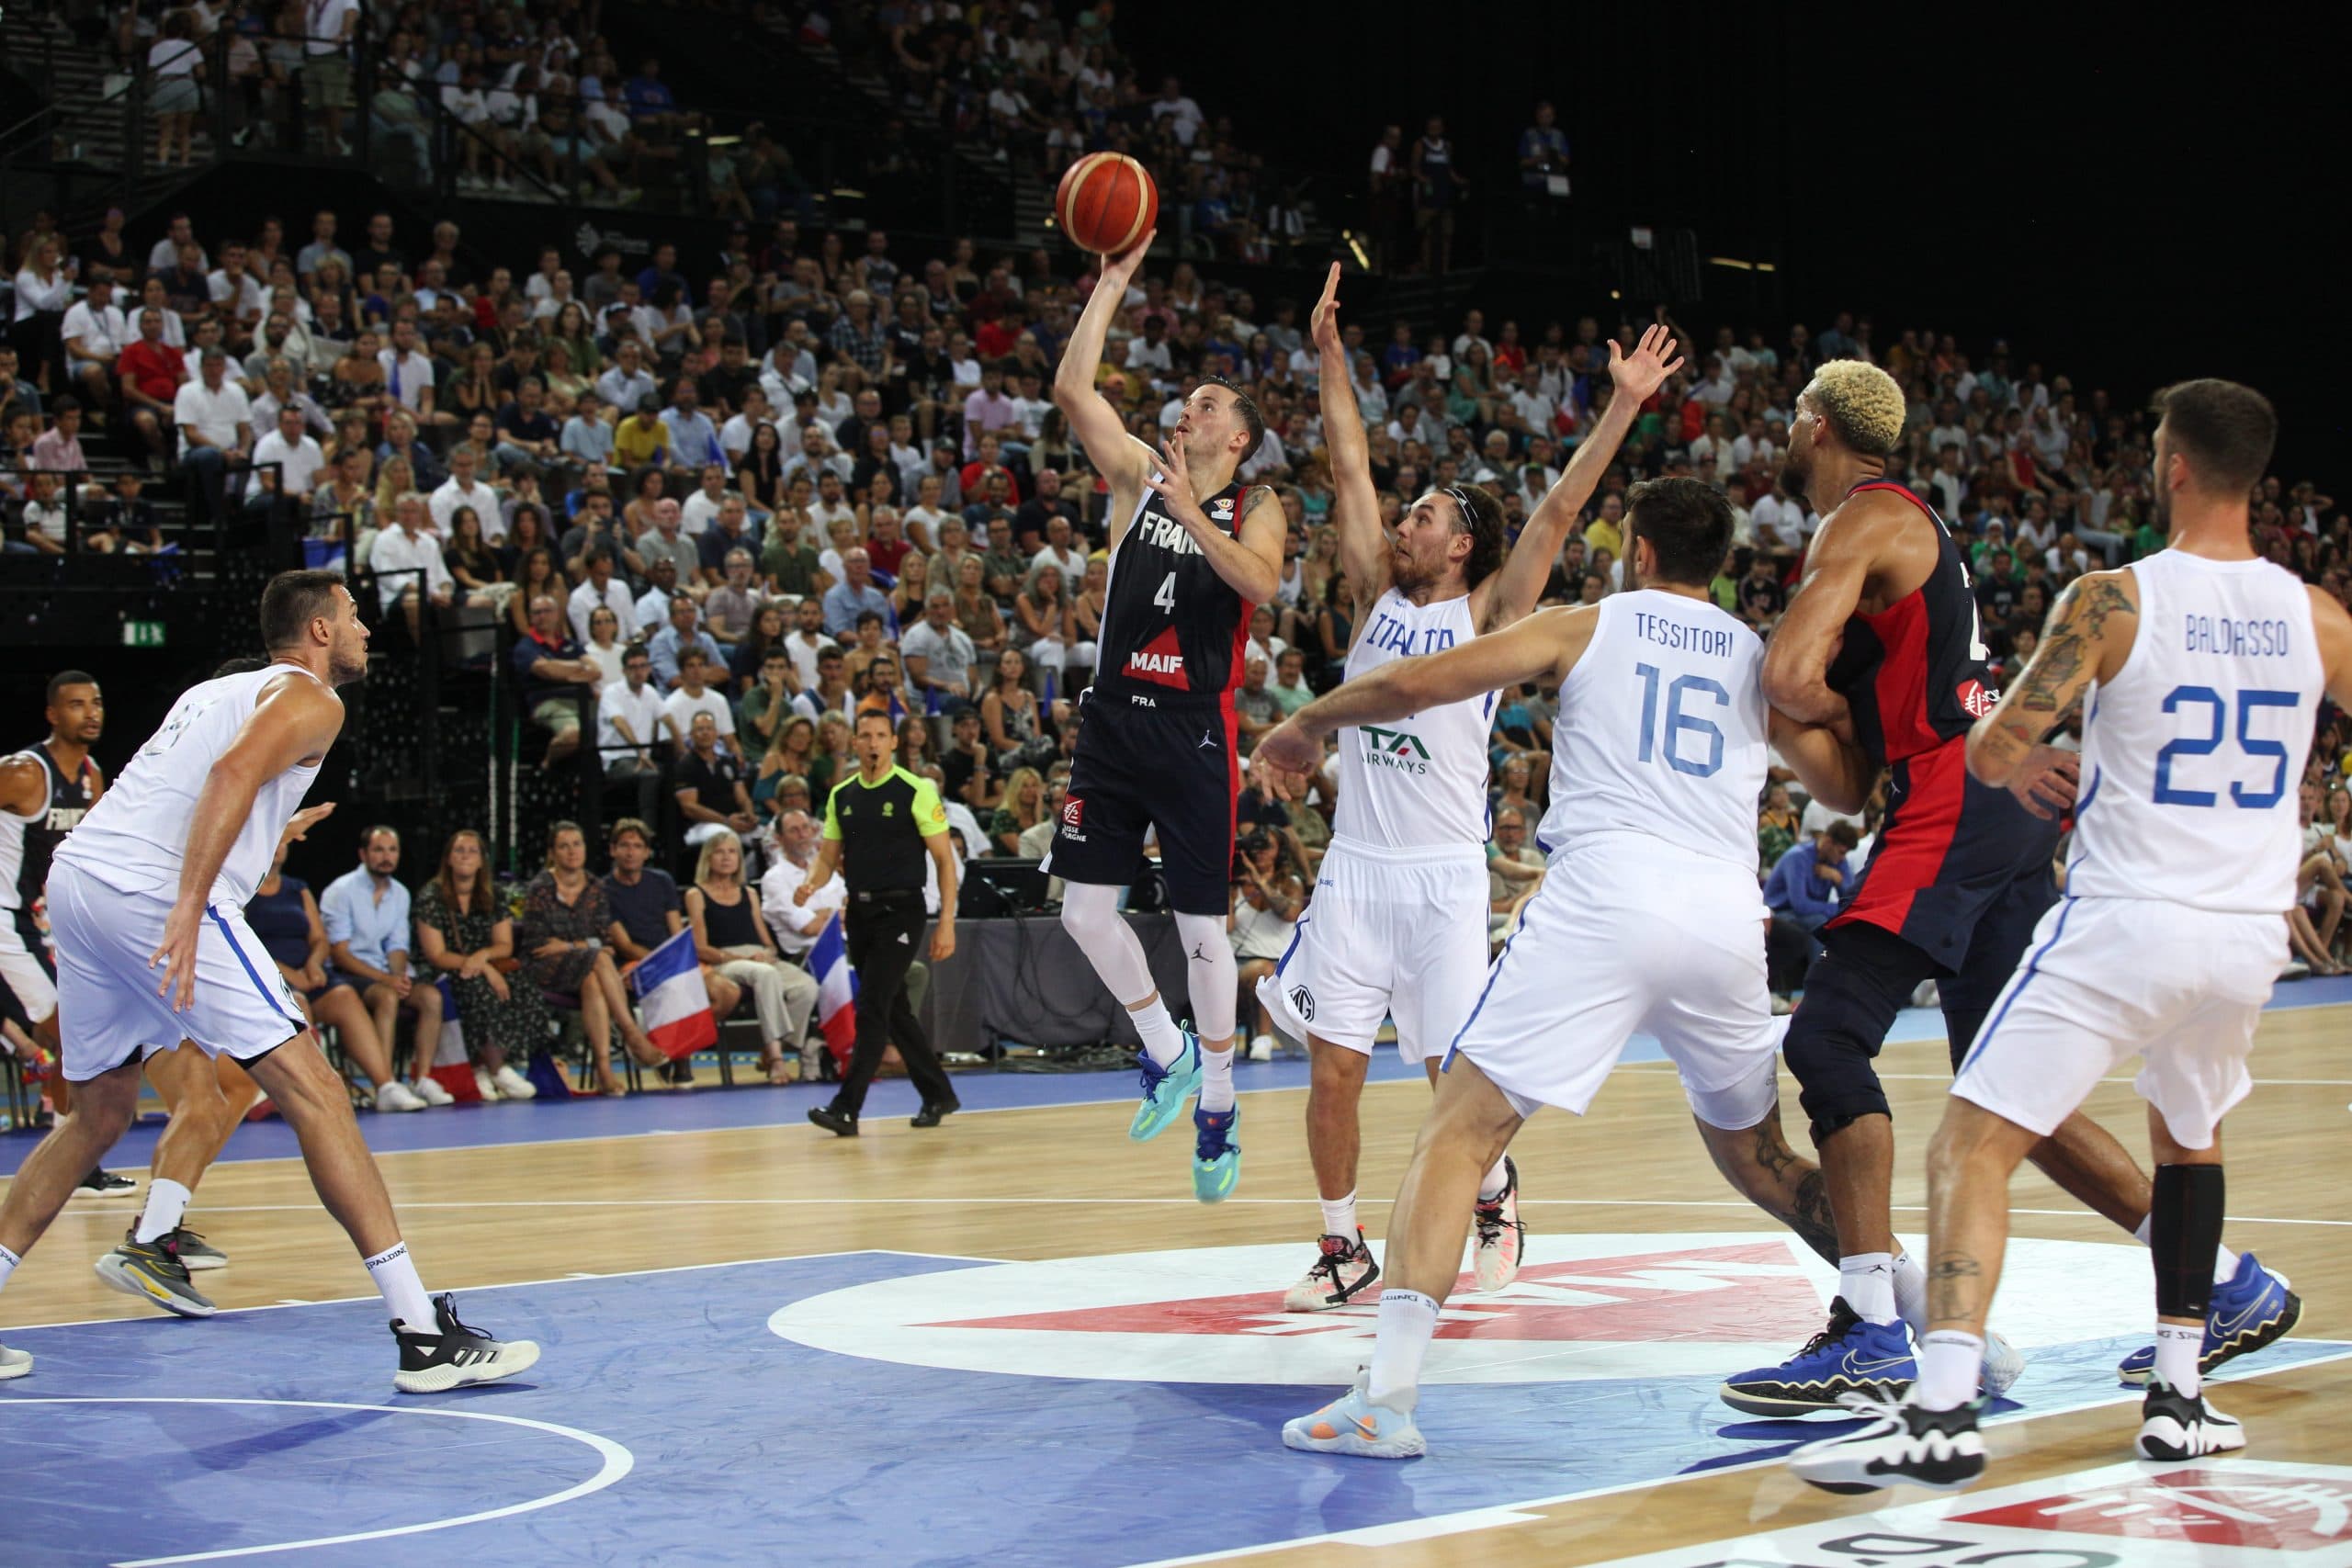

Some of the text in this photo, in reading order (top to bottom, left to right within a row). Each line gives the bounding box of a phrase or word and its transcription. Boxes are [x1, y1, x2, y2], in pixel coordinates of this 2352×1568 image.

[1153, 571, 1177, 615] 4
[1634, 613, 1734, 659] TESSITORI
[2185, 614, 2289, 657] BALDASSO
[1130, 651, 1183, 674] MAIF
[1131, 694, 1156, 708] FRA
[1634, 661, 1730, 779] 16
[2153, 684, 2301, 809] 25
